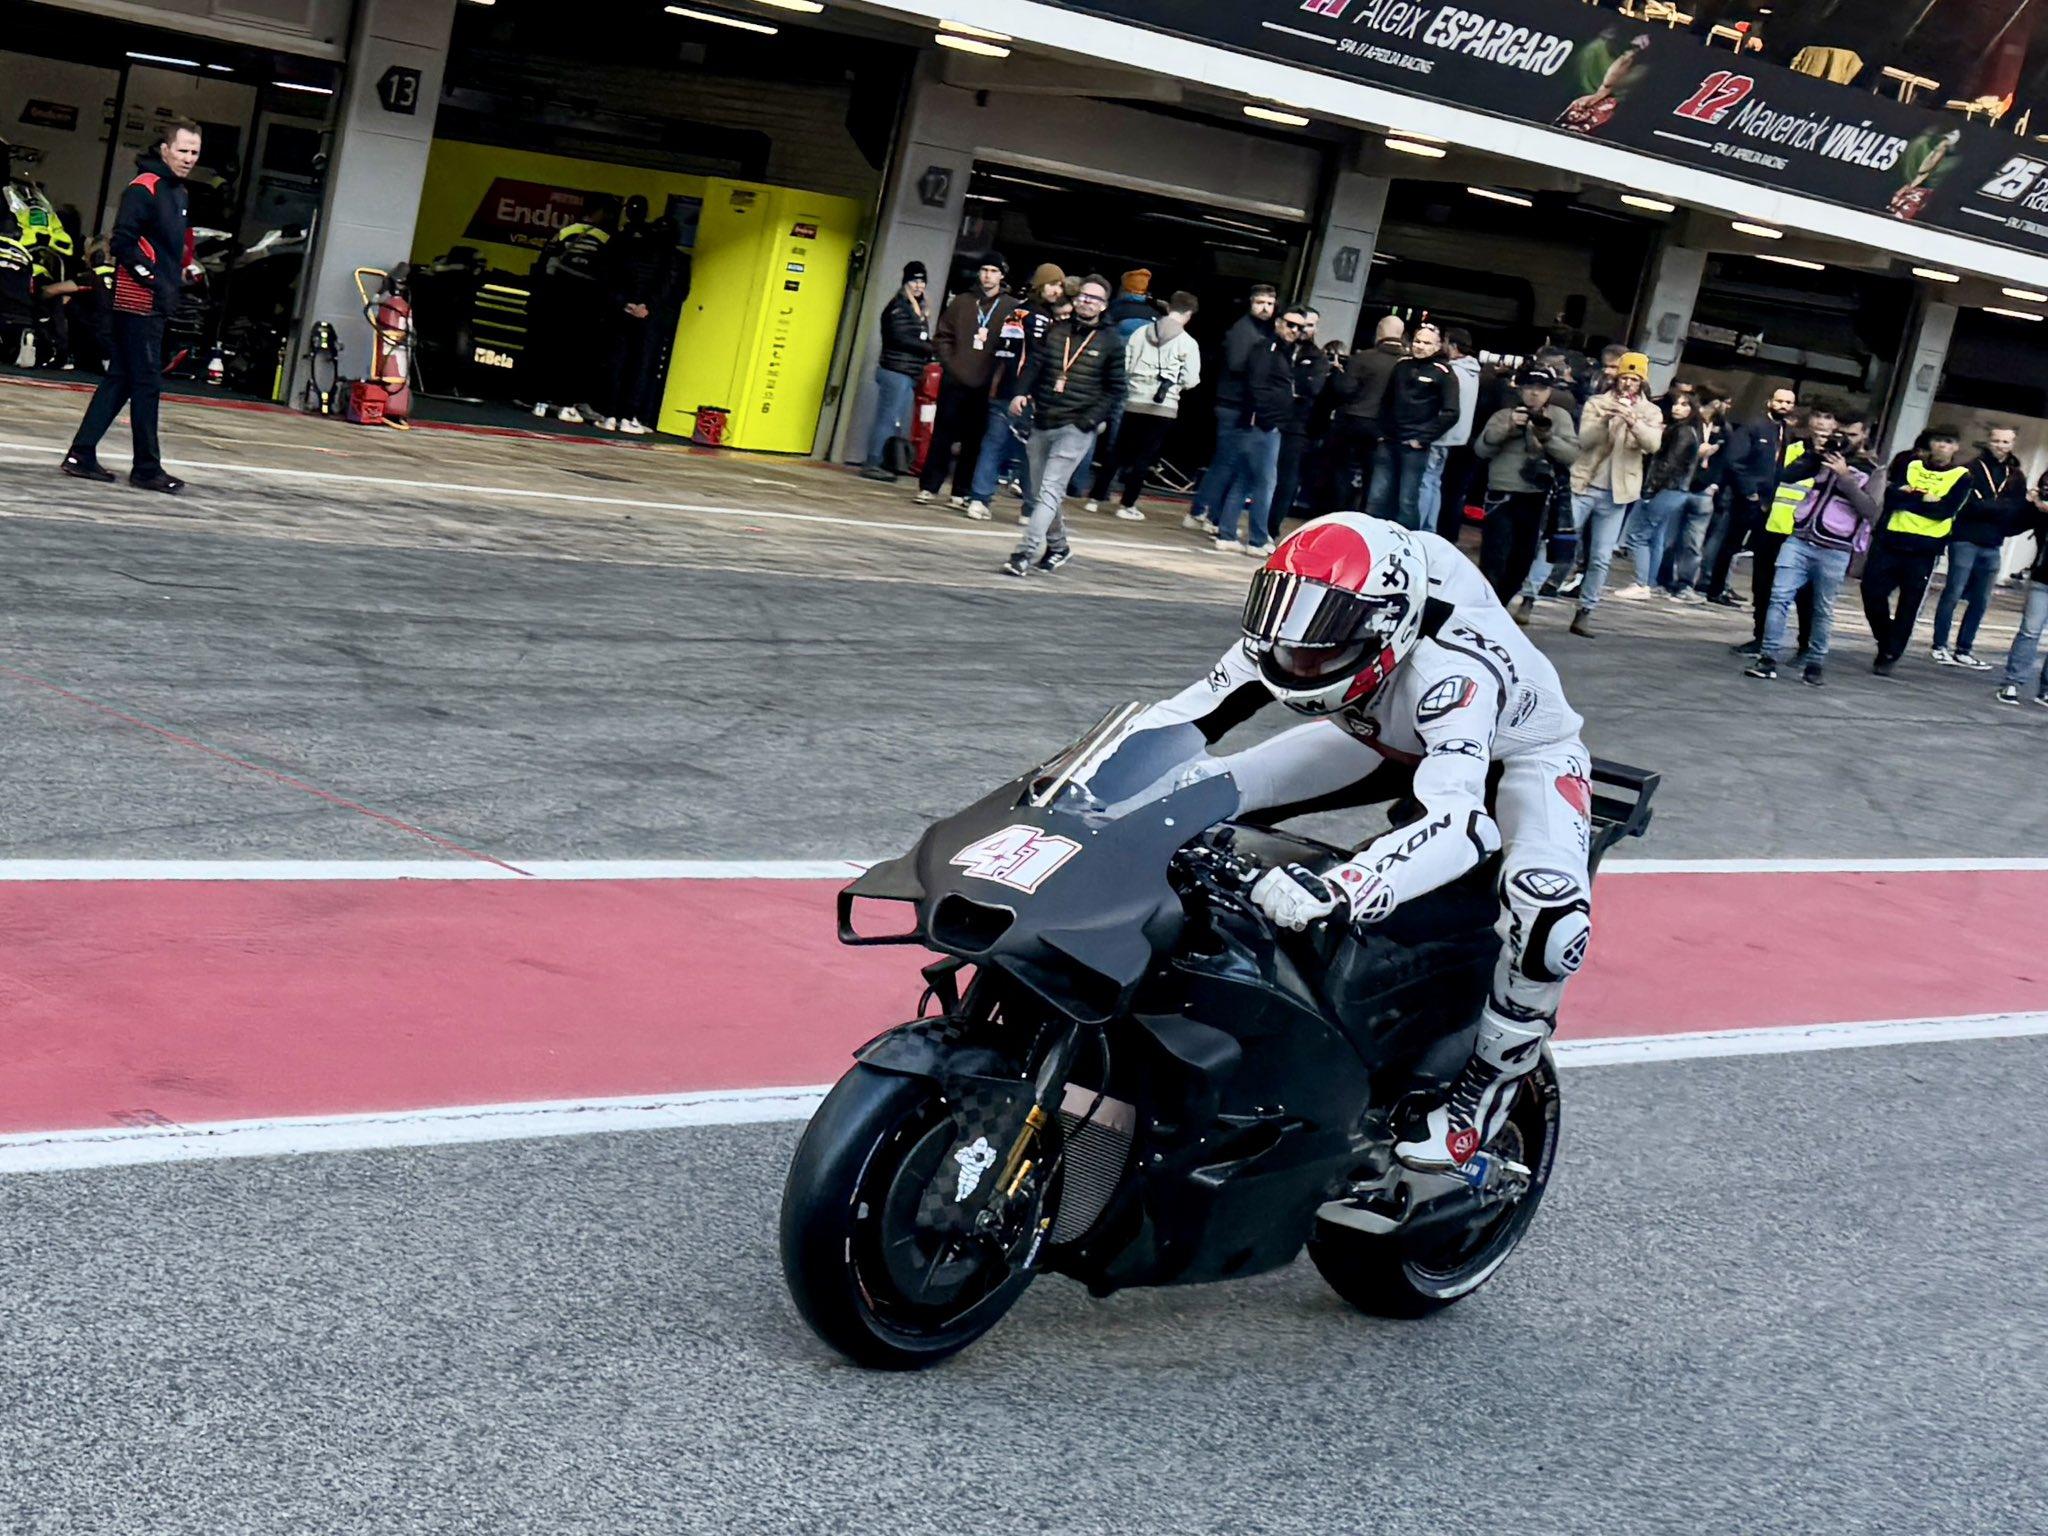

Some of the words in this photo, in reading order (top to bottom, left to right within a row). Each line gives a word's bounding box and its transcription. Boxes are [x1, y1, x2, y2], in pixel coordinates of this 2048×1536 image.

[1352, 0, 1431, 39] Aleix
[1423, 6, 1574, 76] ESPARGARO
[390, 74, 416, 106] 13
[1673, 70, 1755, 125] 12
[1728, 98, 1831, 151] Maverick
[1820, 119, 1908, 171] VIÑALES
[926, 173, 949, 201] 12
[1981, 157, 2048, 199] 25
[497, 197, 575, 230] Endu
[485, 349, 514, 369] Beta
[950, 824, 1083, 895] 41
